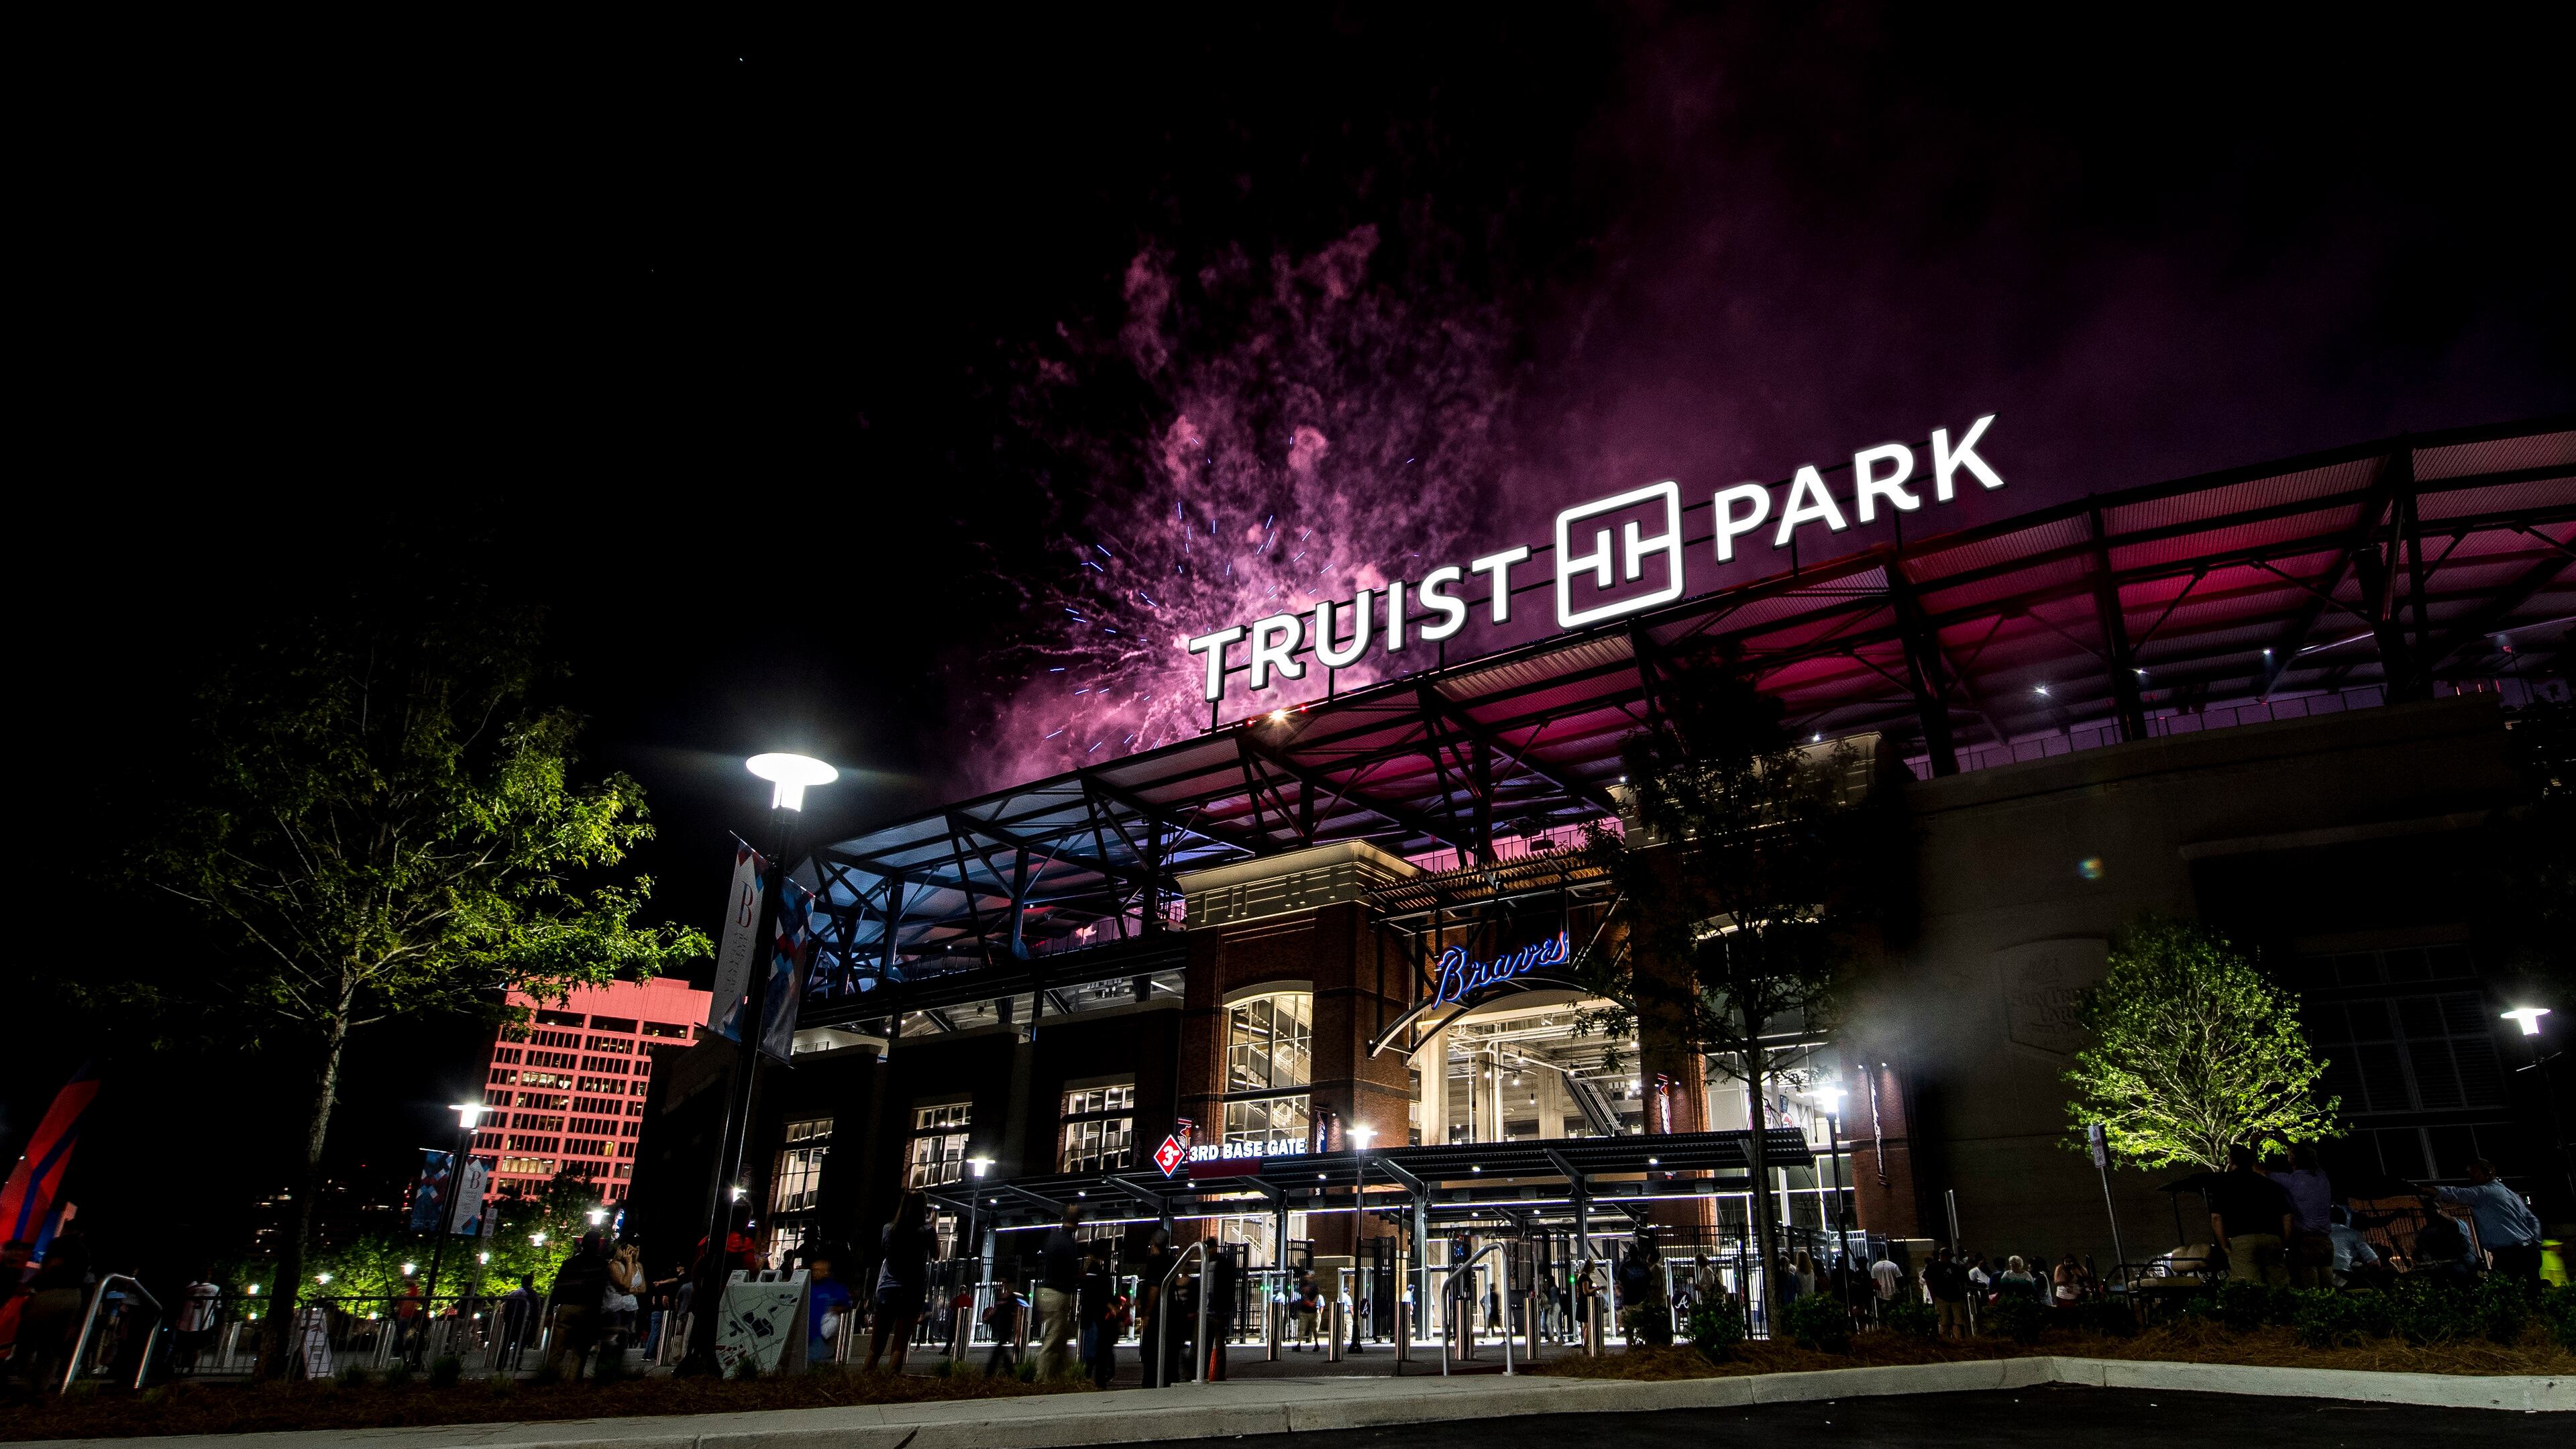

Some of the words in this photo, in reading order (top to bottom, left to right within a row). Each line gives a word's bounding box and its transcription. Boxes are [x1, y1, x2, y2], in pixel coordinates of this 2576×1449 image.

[1189, 545, 1532, 702] TRUIST
[1713, 411, 2007, 565] PARK
[735, 881, 753, 928] B
[1432, 930, 1568, 1010] Braves
[1189, 1144, 1219, 1162] 3RD
[1222, 1141, 1263, 1159] BASE
[1267, 1138, 1306, 1156] GATE
